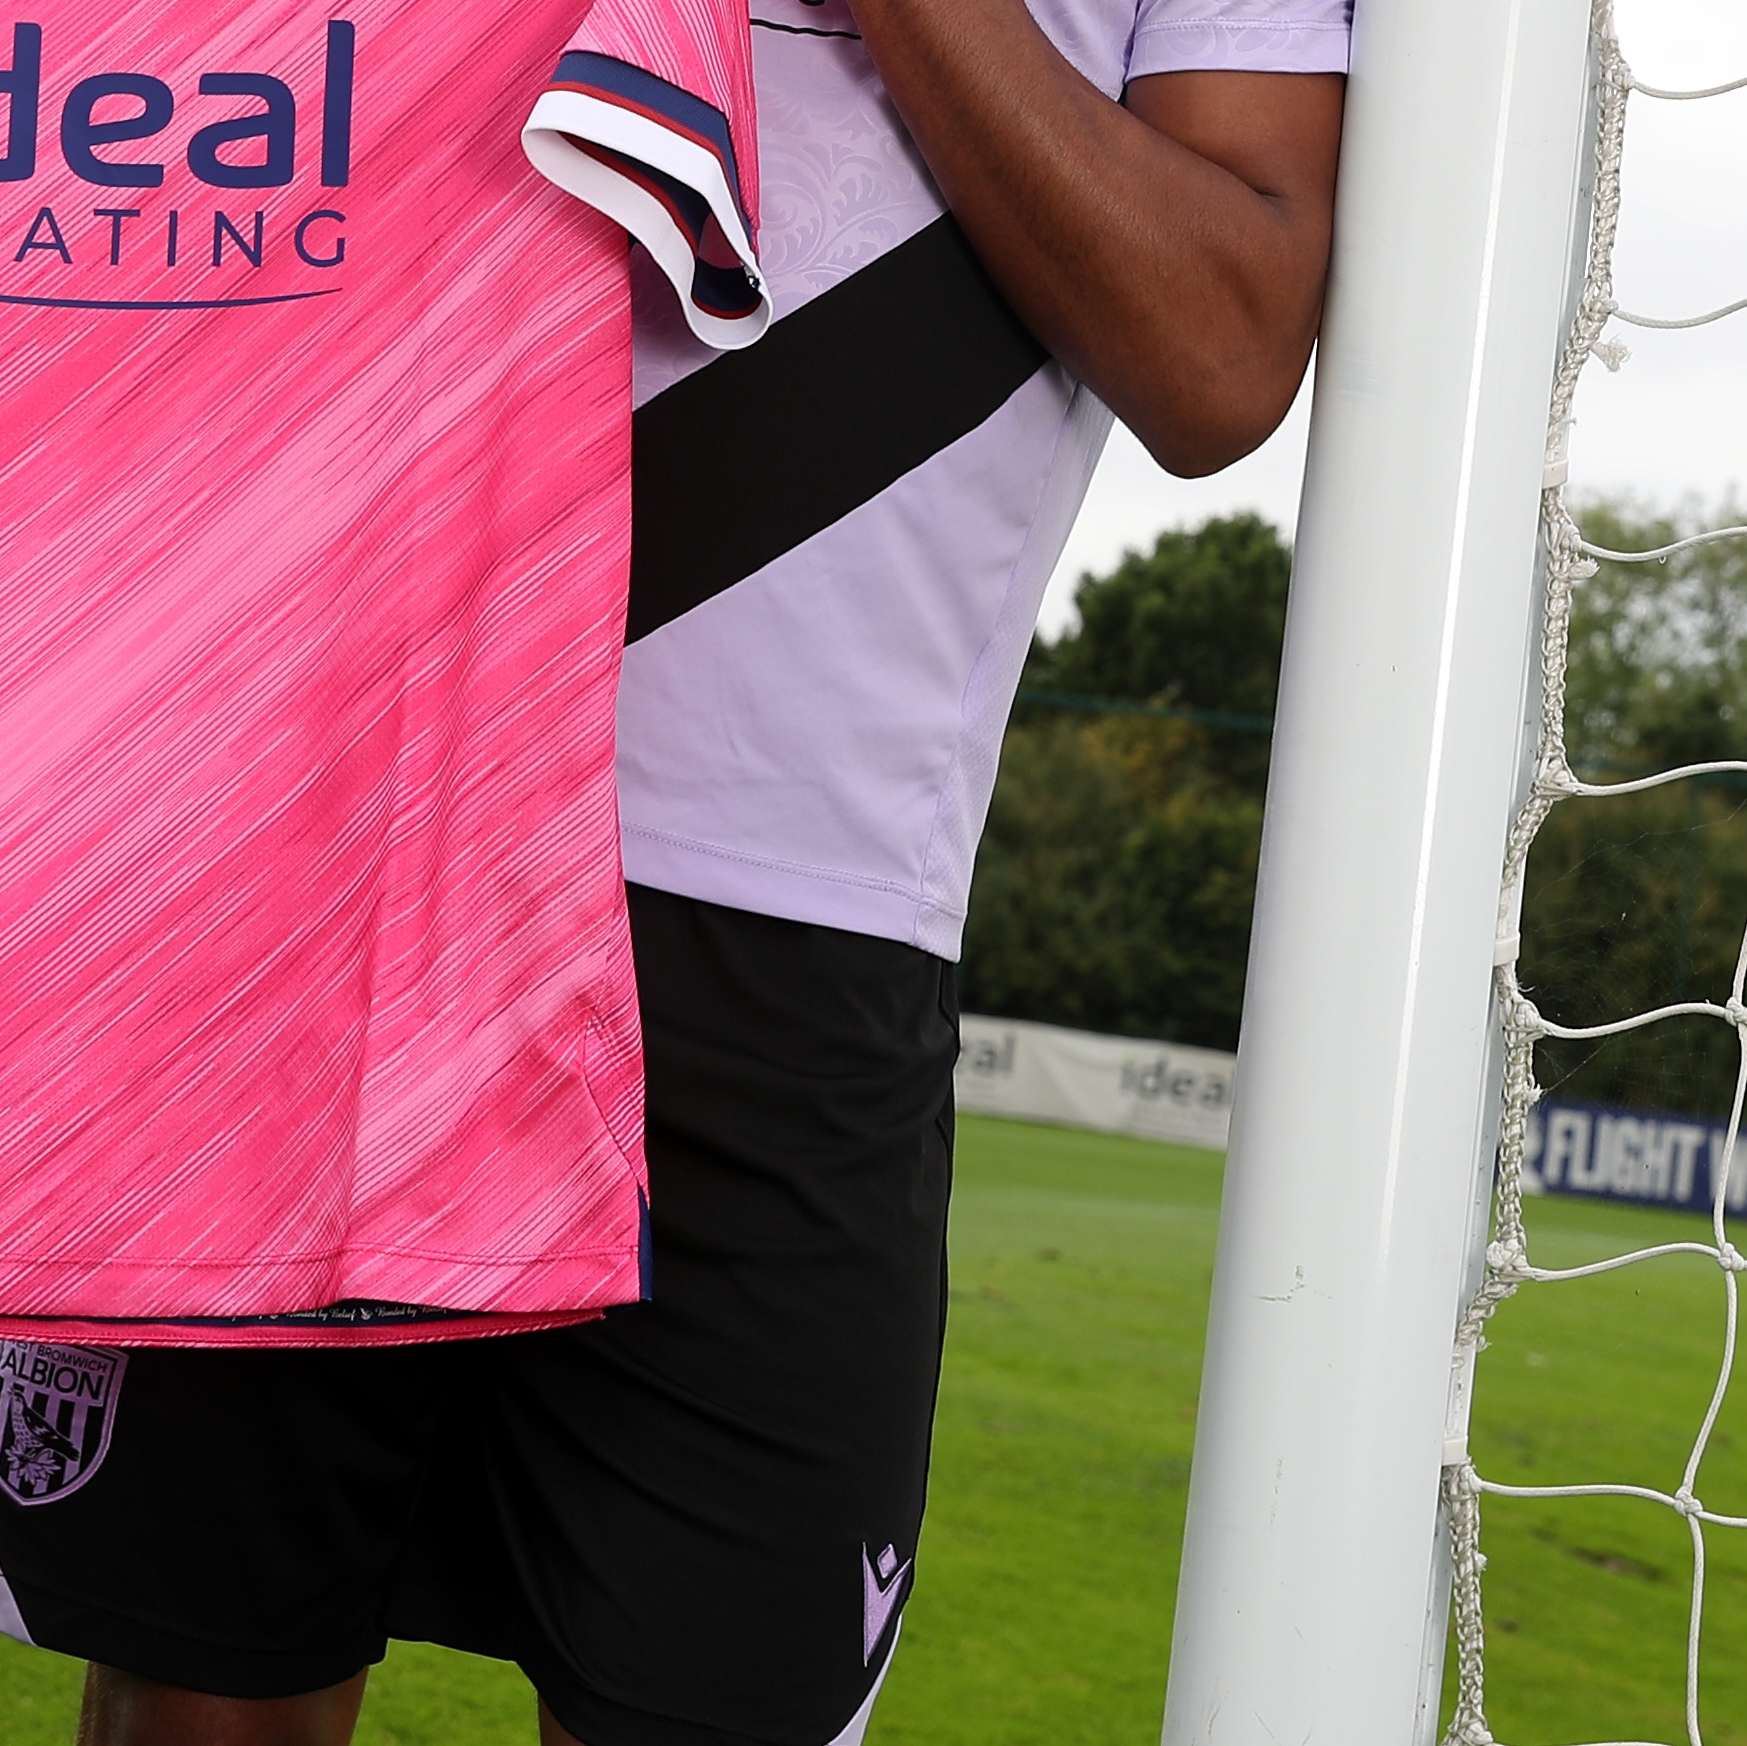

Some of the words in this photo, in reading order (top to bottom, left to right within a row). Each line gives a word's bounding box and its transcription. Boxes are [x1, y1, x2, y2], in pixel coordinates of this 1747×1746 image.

[1119, 1055, 1234, 1111] idea
[1543, 1109, 1708, 1203] FLIGHT
[1, 1347, 104, 1401] ALBION
[37, 1344, 108, 1373] BROMWICH
